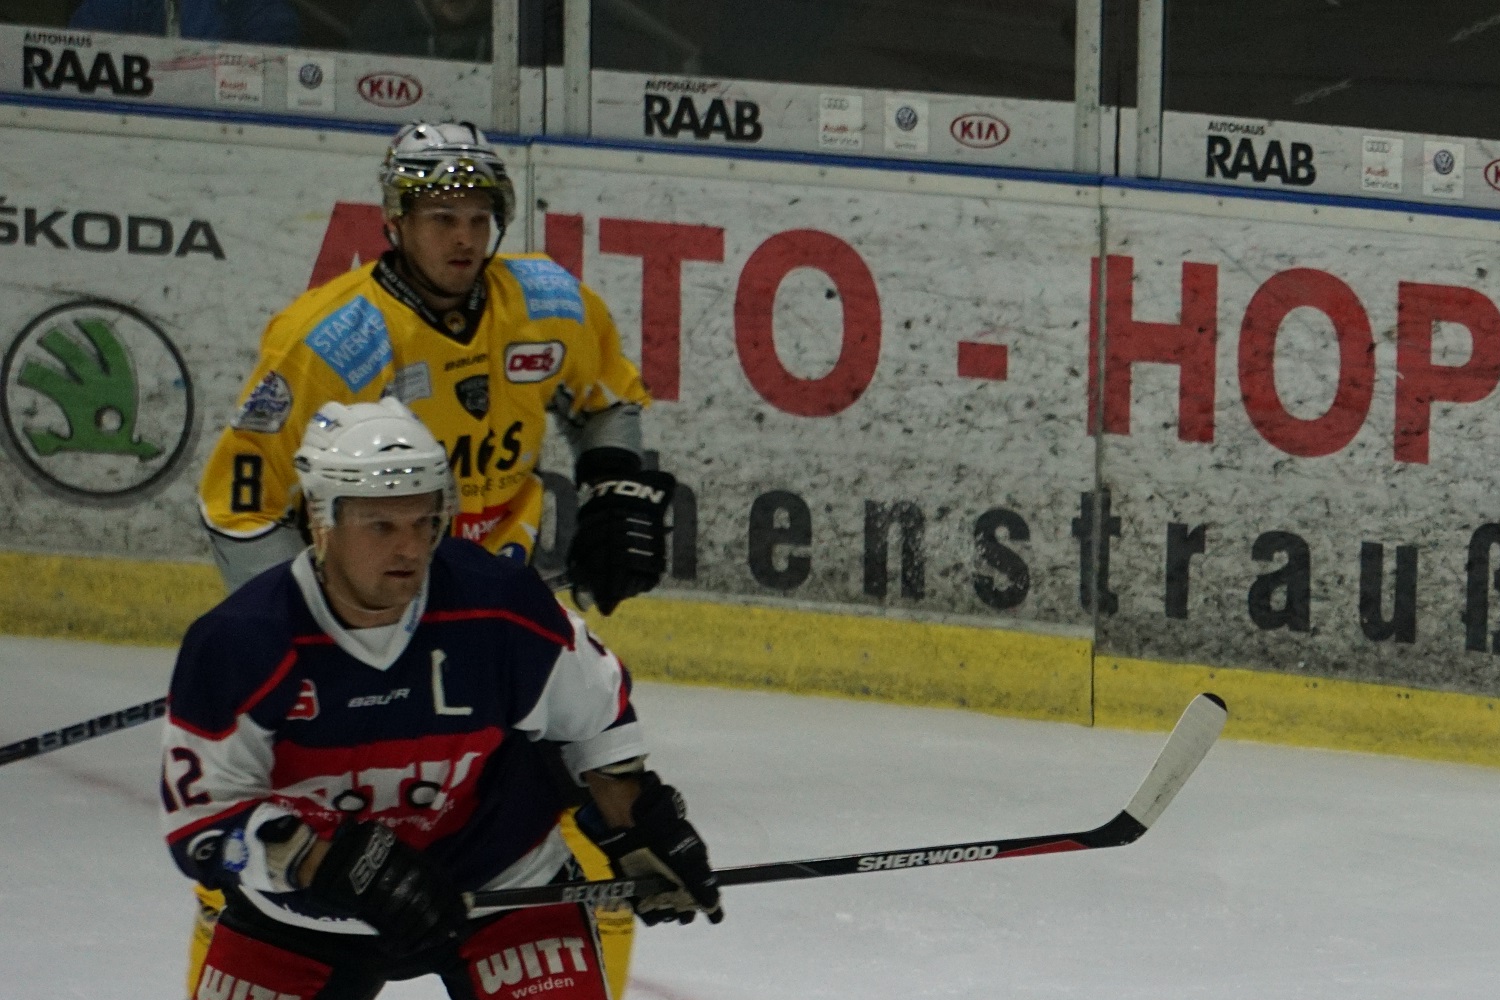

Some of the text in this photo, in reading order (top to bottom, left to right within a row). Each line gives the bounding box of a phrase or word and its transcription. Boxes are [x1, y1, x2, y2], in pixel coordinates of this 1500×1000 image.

[23, 46, 153, 97] RAAB
[644, 94, 762, 143] RAAB
[1207, 121, 1265, 136] AUTOHAUS
[1206, 135, 1317, 186] RAAB
[231, 455, 262, 512] 8
[431, 649, 474, 716] L
[476, 936, 591, 996] WITT
[511, 975, 575, 999] weiden
